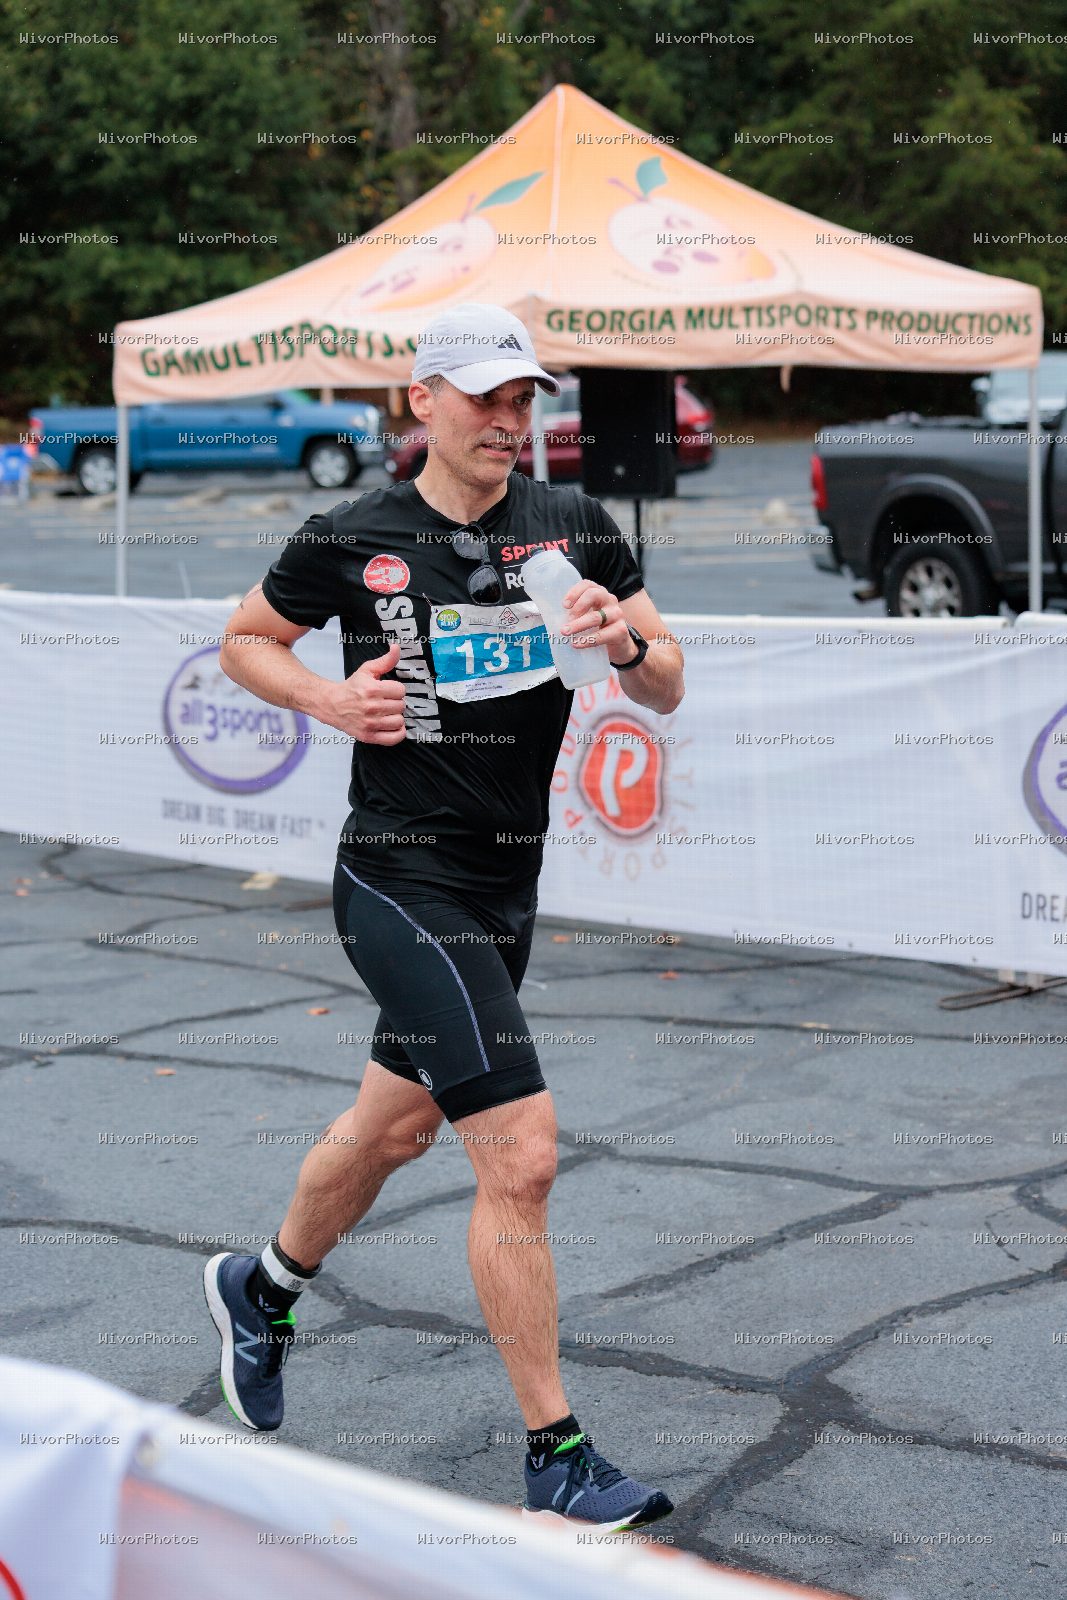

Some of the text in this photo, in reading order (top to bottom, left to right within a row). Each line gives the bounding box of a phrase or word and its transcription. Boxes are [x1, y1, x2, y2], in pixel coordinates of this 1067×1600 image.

[546, 304, 1032, 336] GEORGIA MULTISPORTS PRODUCTIONS
[374, 595, 442, 741] SPARTAN
[456, 636, 532, 675] 131
